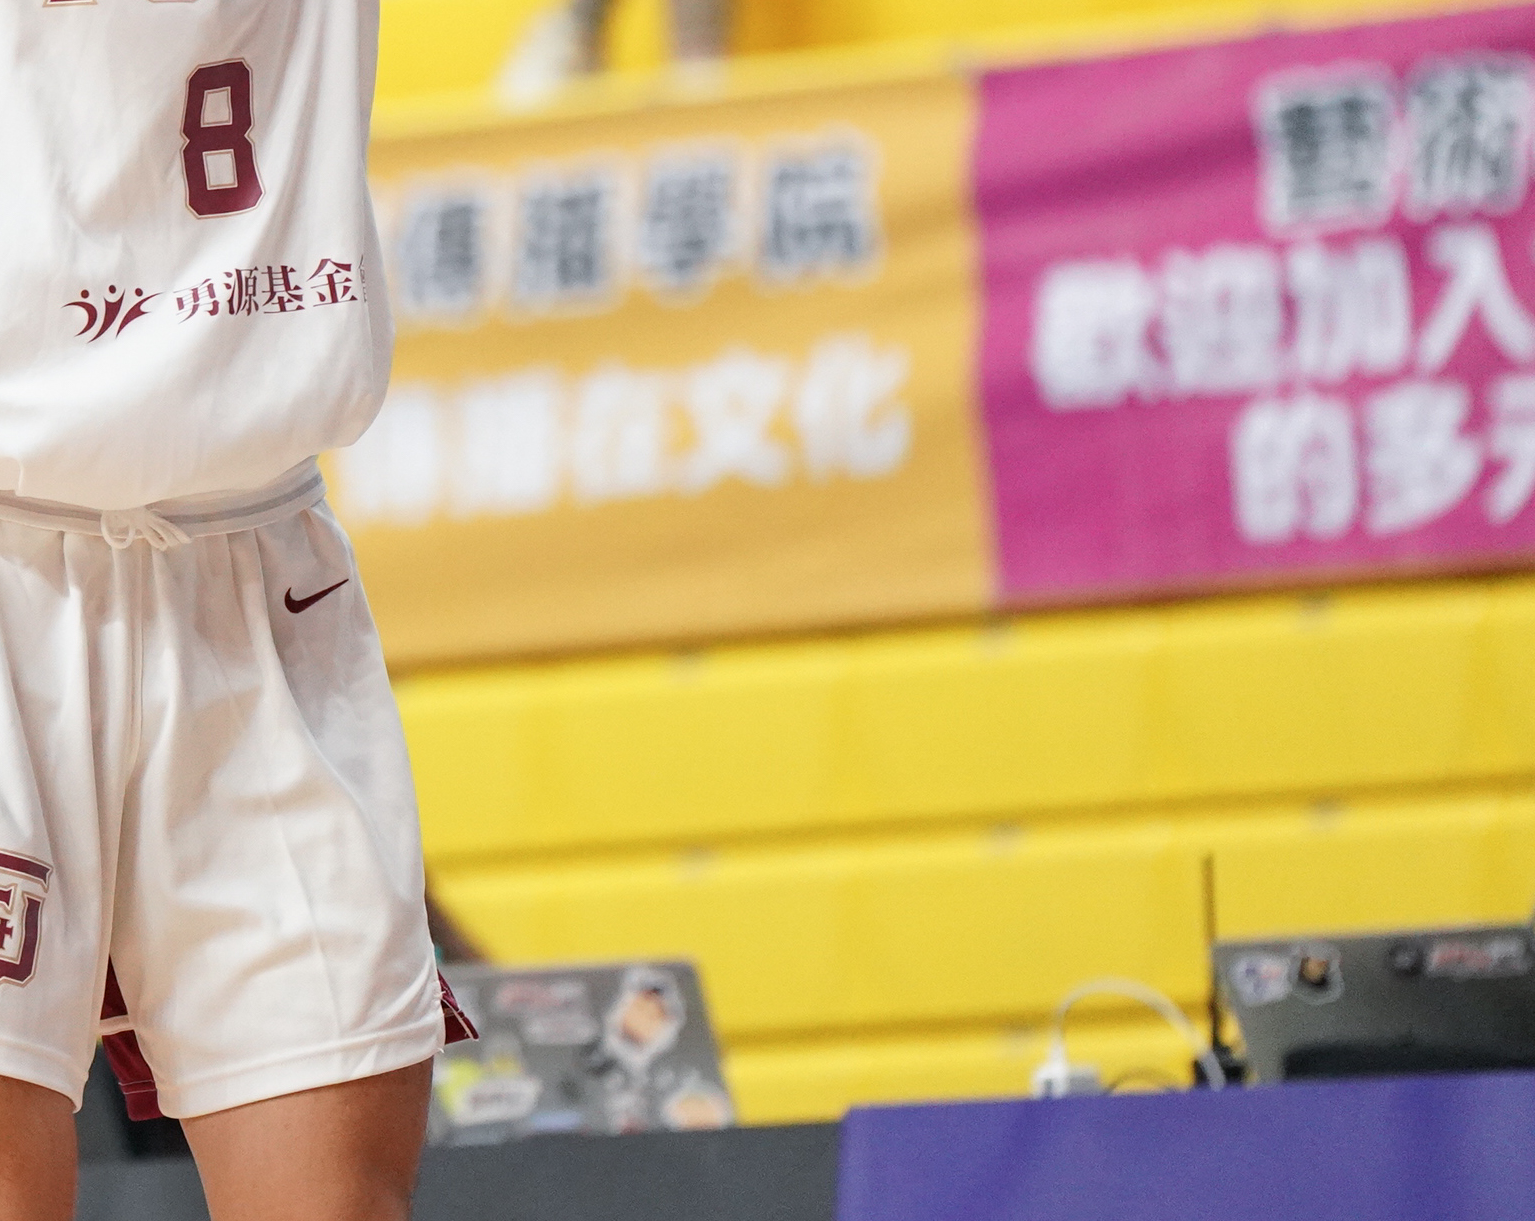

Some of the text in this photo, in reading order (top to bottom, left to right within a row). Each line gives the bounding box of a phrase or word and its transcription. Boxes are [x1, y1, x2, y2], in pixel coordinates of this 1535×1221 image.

[179, 57, 267, 220] 8
[172, 255, 368, 325] 勇源基金
